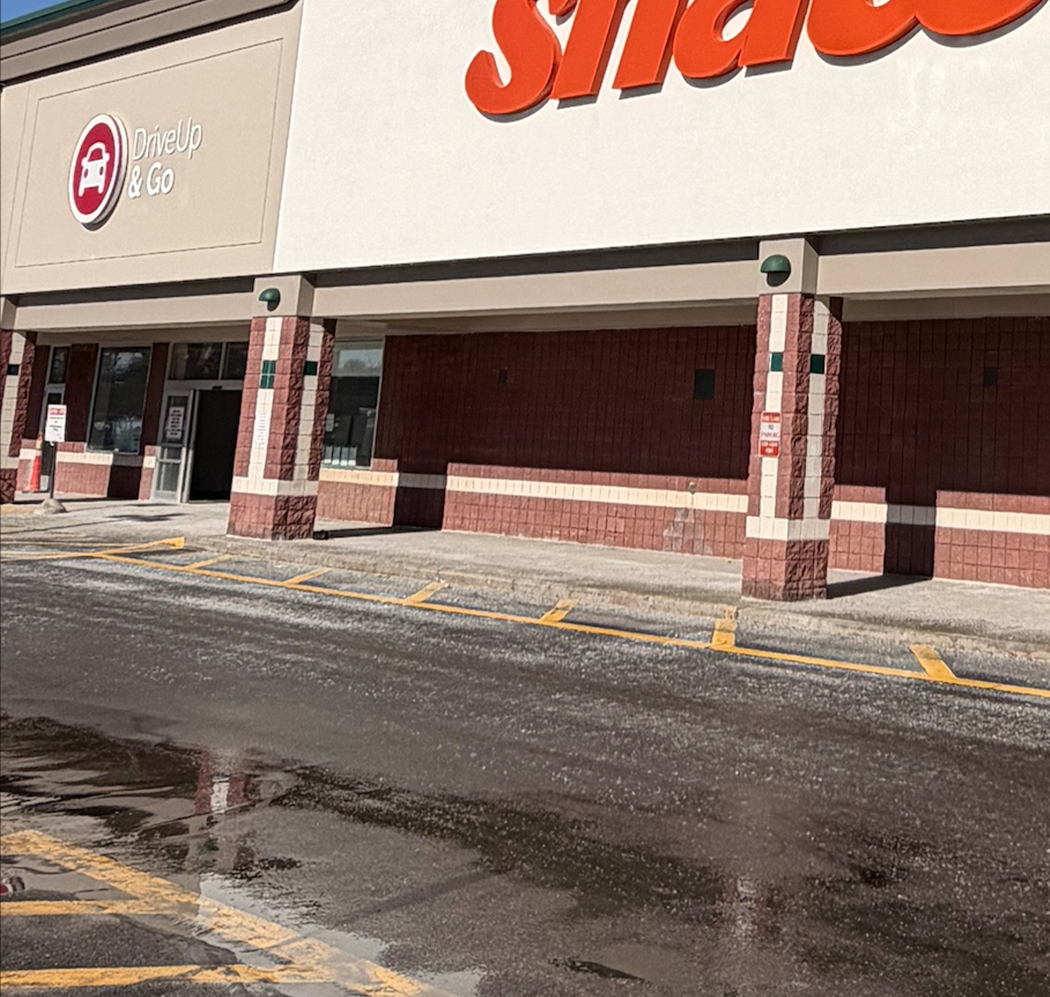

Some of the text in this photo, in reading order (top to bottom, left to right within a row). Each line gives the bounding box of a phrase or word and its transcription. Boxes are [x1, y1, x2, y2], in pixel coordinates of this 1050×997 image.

[132, 117, 203, 161] DriveUp
[128, 161, 175, 199] & Go
